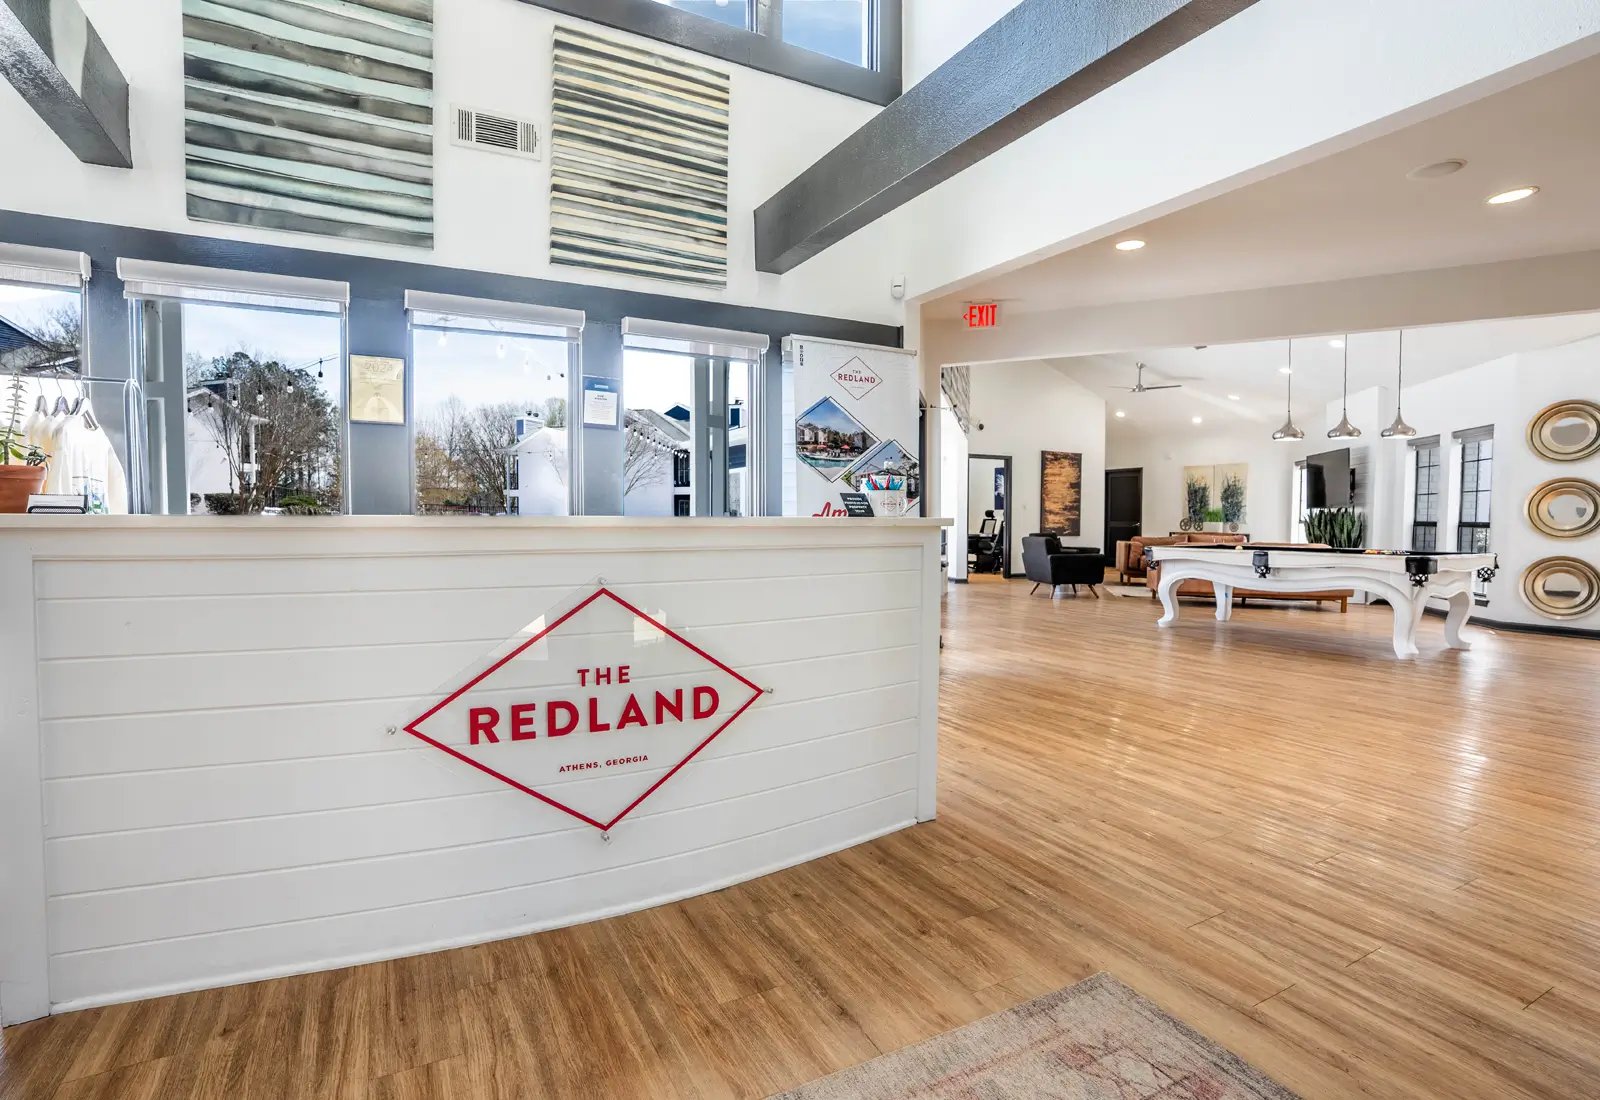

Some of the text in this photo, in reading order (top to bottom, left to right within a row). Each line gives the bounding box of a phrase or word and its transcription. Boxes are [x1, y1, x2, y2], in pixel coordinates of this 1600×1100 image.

[969, 304, 998, 327] EXIT
[837, 373, 876, 384] REDLAND
[576, 665, 631, 687] THE
[469, 685, 720, 745] REDLAND
[559, 755, 649, 773] ATHENS, GEORGIA
